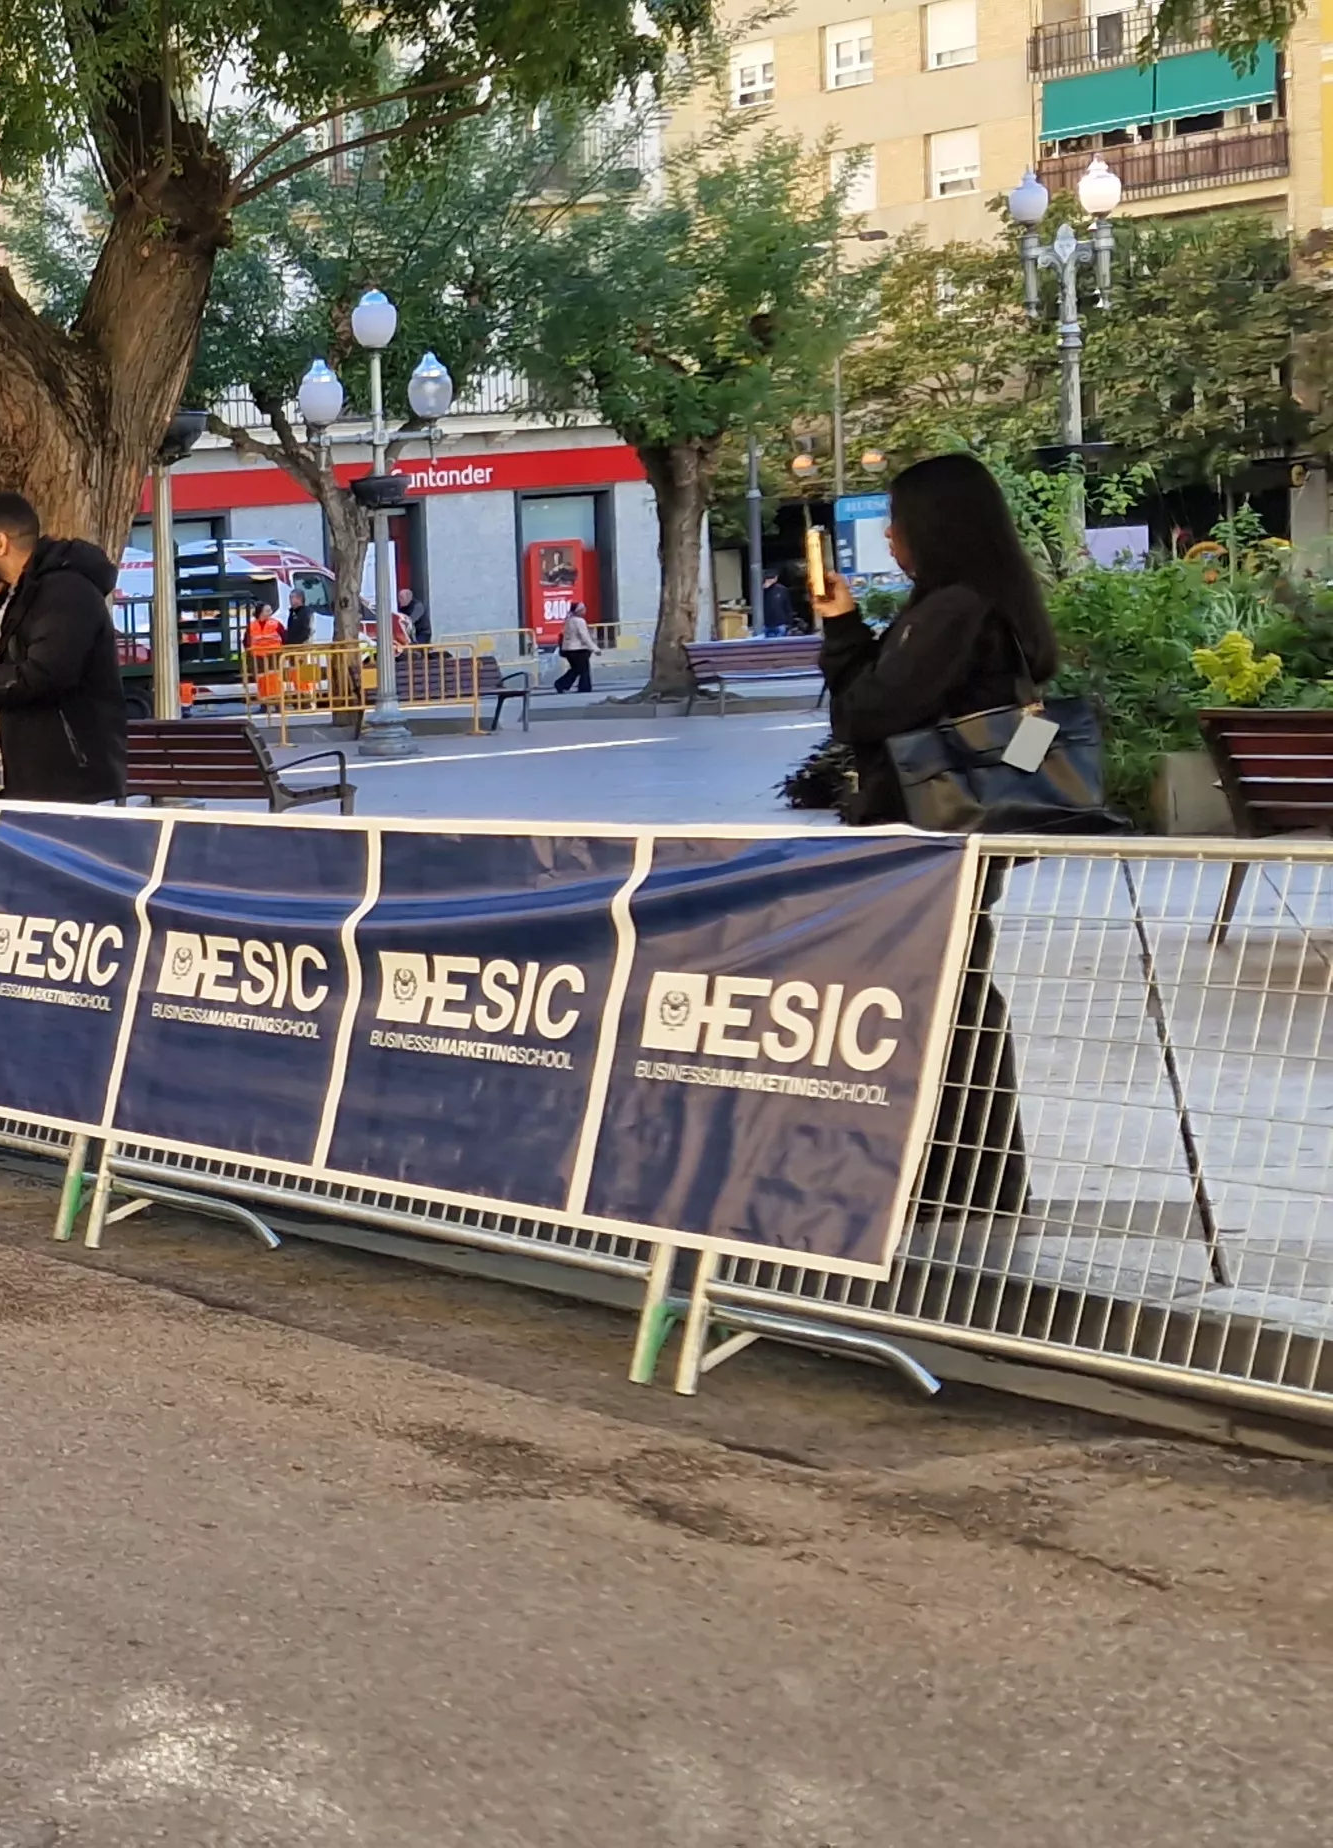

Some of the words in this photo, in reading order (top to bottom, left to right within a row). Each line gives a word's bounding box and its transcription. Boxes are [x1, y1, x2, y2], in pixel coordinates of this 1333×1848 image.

[14, 917, 124, 987] ESIC
[200, 935, 329, 1012] ESIC
[151, 1002, 321, 1039] BUSINESS&MARKETINGSCHOOL
[428, 954, 586, 1039] ESIC
[703, 975, 903, 1072] ESIC
[369, 1029, 574, 1070] BUSINESS&MARKETINGSCHOOL
[634, 1060, 890, 1107] BUSINESS&MARKETINGSCHOOL
